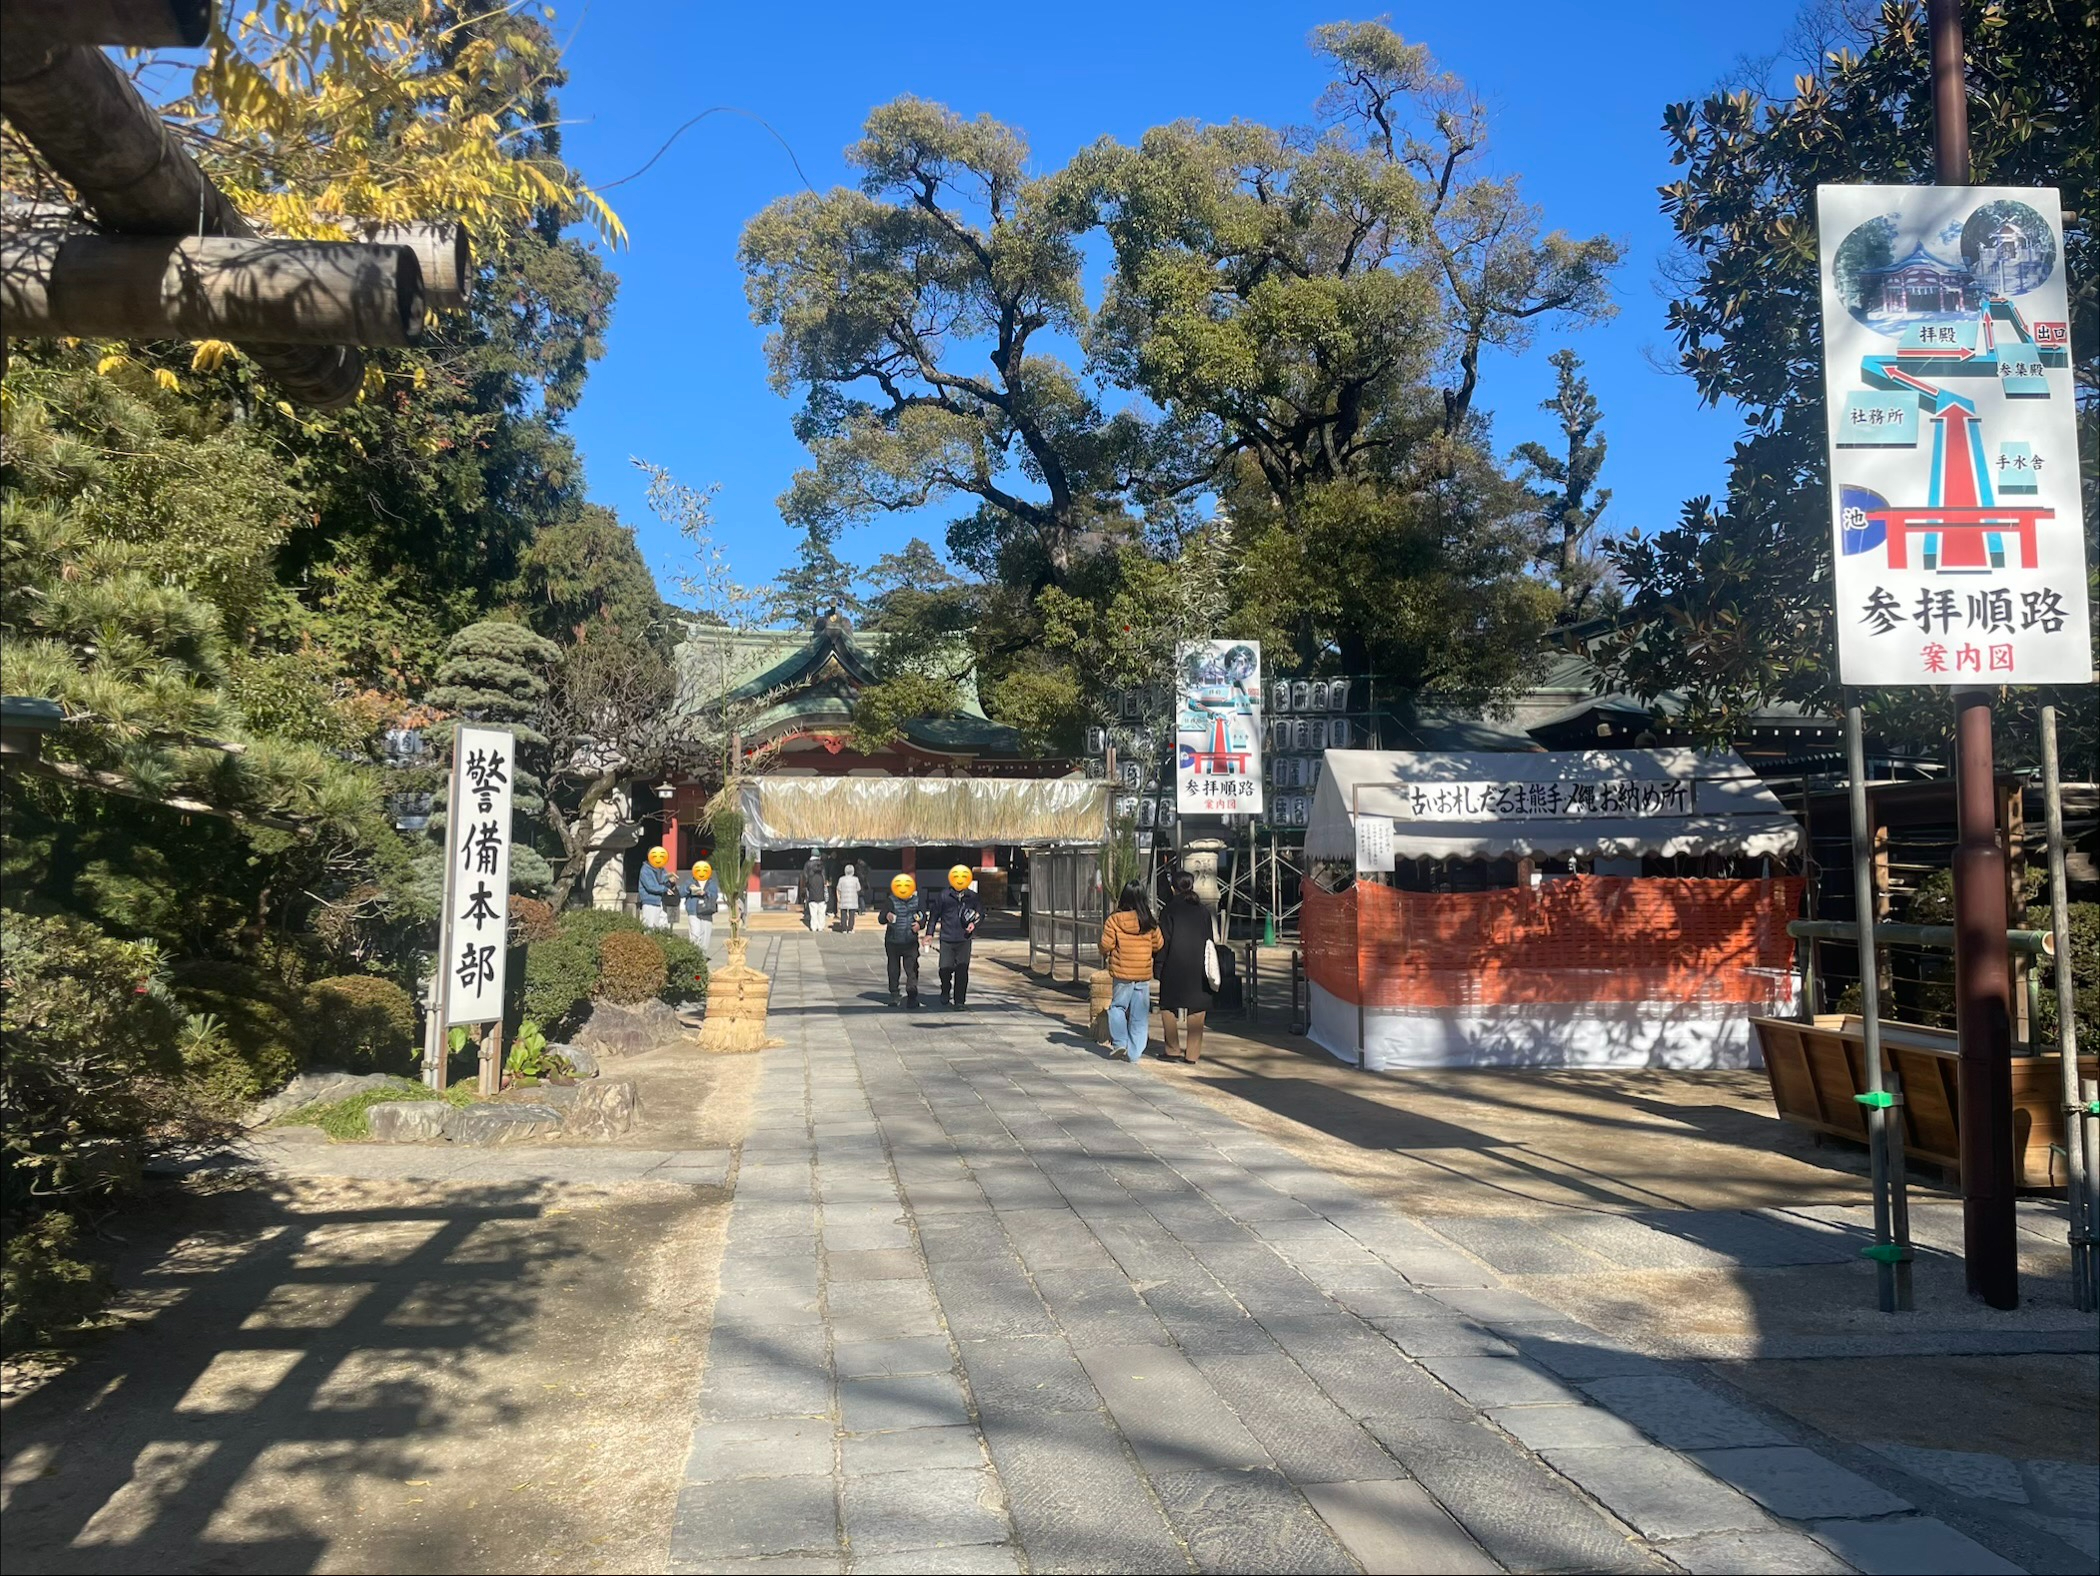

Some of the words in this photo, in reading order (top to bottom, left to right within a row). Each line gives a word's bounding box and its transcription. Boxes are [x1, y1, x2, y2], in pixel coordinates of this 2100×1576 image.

[1919, 326, 1957, 343] 拝殿
[2038, 325, 2067, 341] 出口
[1999, 363, 2044, 377] 参集殿
[1850, 408, 1904, 425] 社務所
[1844, 508, 1867, 529] 池
[1858, 586, 2069, 636] 参拝順路
[1920, 643, 2015, 673] 案内図
[1185, 779, 1255, 797] 参拝順路
[1204, 799, 1237, 810] 案内図
[456, 748, 508, 998] 警備本部
